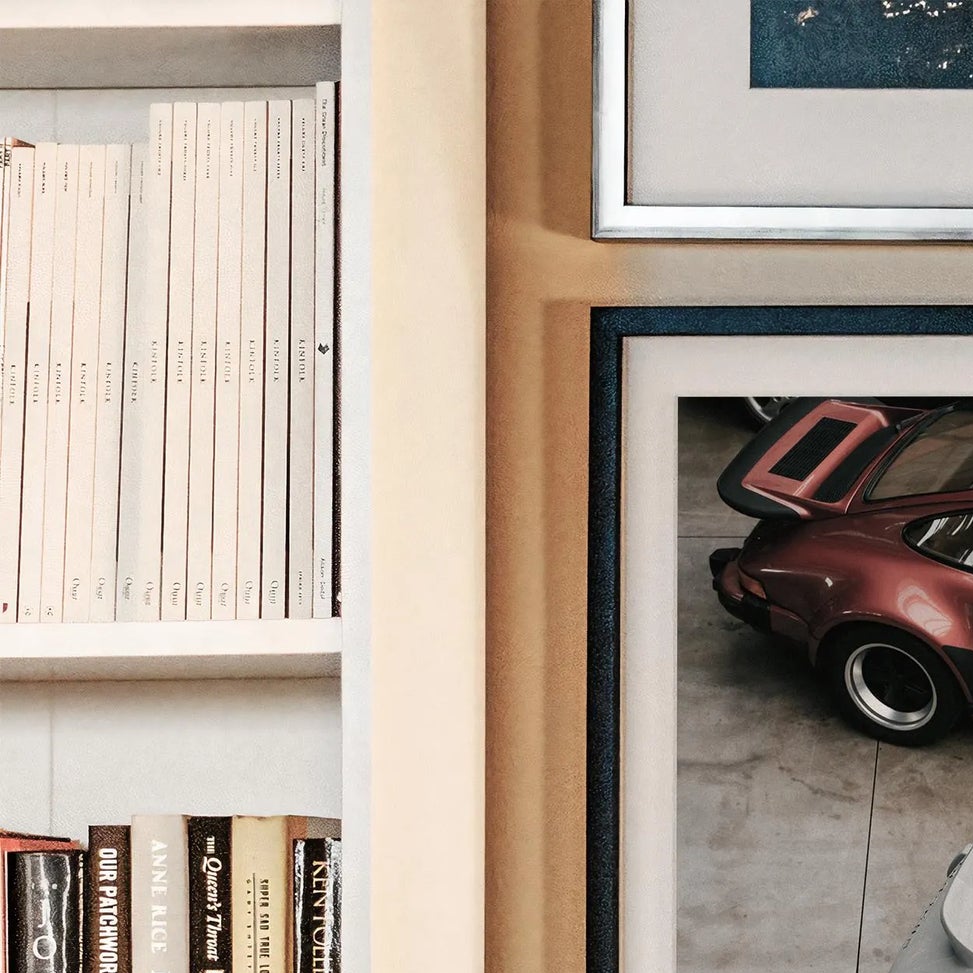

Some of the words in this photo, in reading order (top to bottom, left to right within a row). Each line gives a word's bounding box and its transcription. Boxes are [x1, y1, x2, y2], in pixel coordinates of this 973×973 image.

[98, 848, 118, 882] OUR
[150, 839, 168, 897] ANNE
[202, 856, 223, 911] Queen's
[312, 860, 330, 907] KEN
[259, 878, 270, 908] SUPER
[151, 904, 167, 954] RICE
[206, 913, 222, 962] Throat
[259, 913, 270, 931] SAD
[259, 936, 270, 959] TRUE
